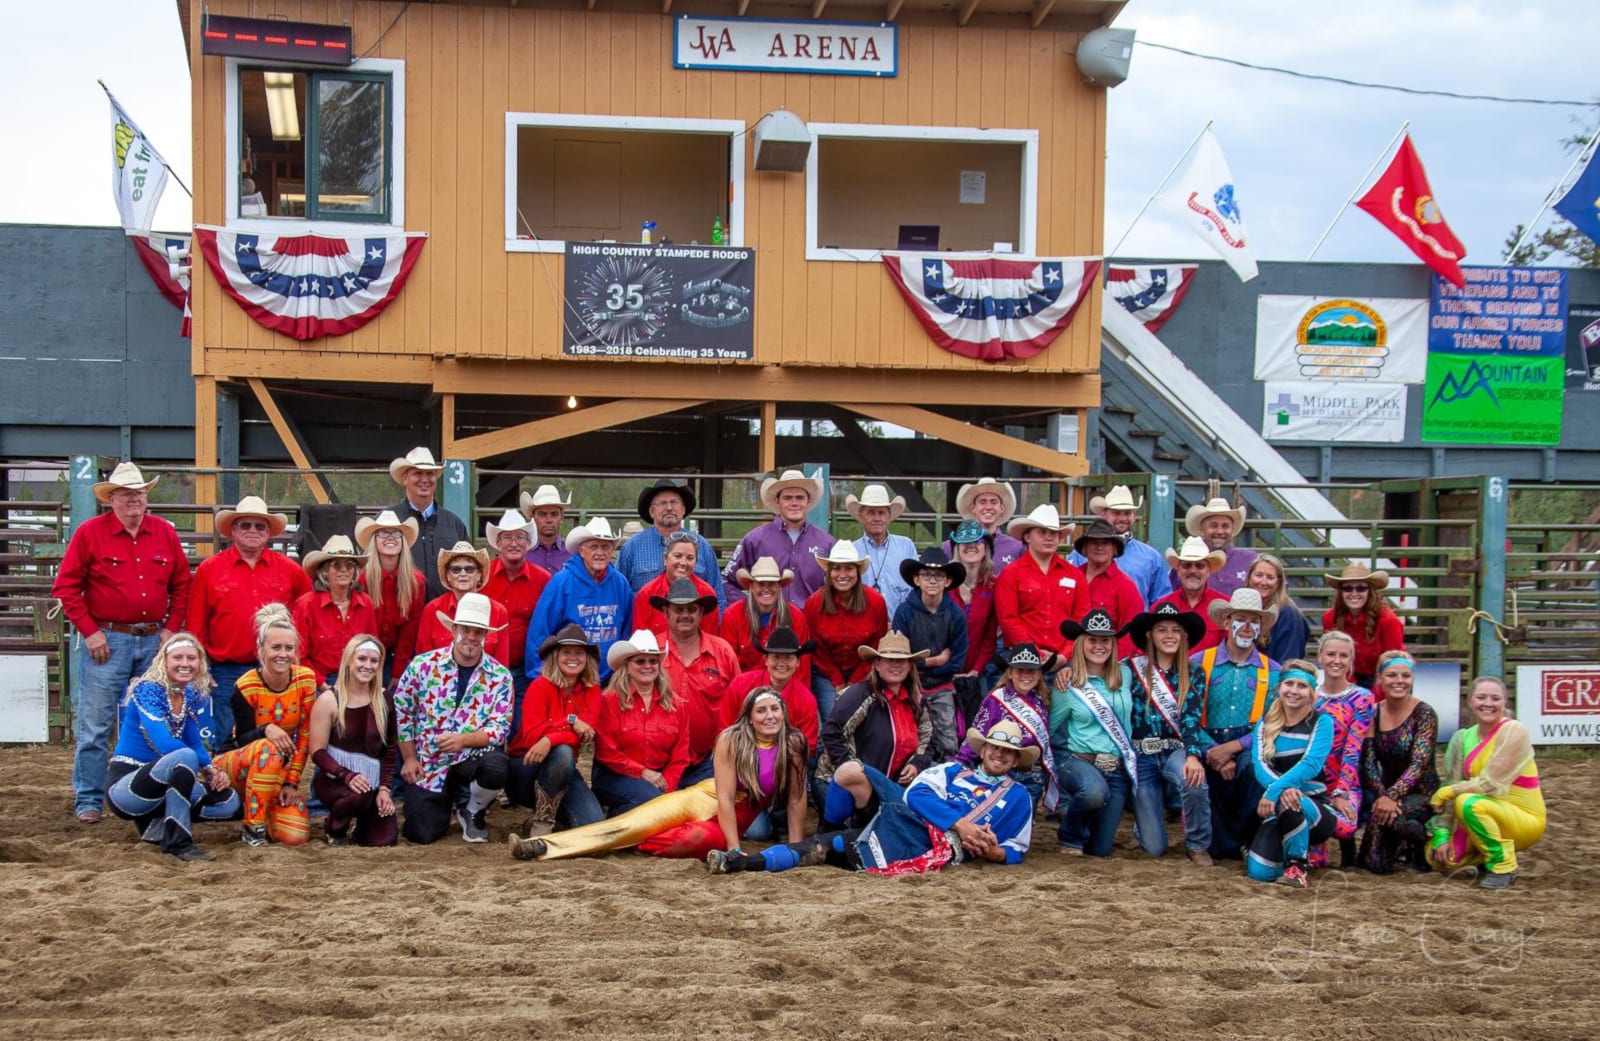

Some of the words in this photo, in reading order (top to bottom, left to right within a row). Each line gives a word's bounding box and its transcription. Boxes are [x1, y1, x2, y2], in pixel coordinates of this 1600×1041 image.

[768, 33, 881, 61] ARENA
[132, 167, 148, 202] eat
[572, 245, 600, 255] HIGH
[601, 246, 653, 257] COUNTRY
[654, 248, 710, 259] STAMPEDE
[712, 250, 749, 260] RODEO
[1511, 269, 1531, 283] TO
[1533, 270, 1561, 285] OUR
[1510, 286, 1539, 300] AND
[1541, 286, 1560, 300] TO
[1439, 299, 1483, 314] THOSE
[1485, 301, 1543, 316] SERVING
[1545, 302, 1560, 316] IN
[1432, 315, 1460, 329] OUR
[1462, 316, 1509, 331] ARMED
[1511, 317, 1564, 332] FORCES
[1453, 333, 1504, 349] THANK
[1507, 335, 1542, 350] YOU!
[634, 346, 698, 359] Celebrating
[699, 348, 714, 357] 35
[716, 348, 748, 358] Years
[1302, 395, 1359, 408] MIDDLE
[1365, 396, 1400, 409] PARK
[1302, 408, 1352, 416] MEDICAL
[76, 456, 92, 479] 2
[449, 461, 465, 485] 3
[1155, 474, 1169, 497] 5
[1489, 476, 1504, 499] 6
[1087, 691, 1110, 723] Country
